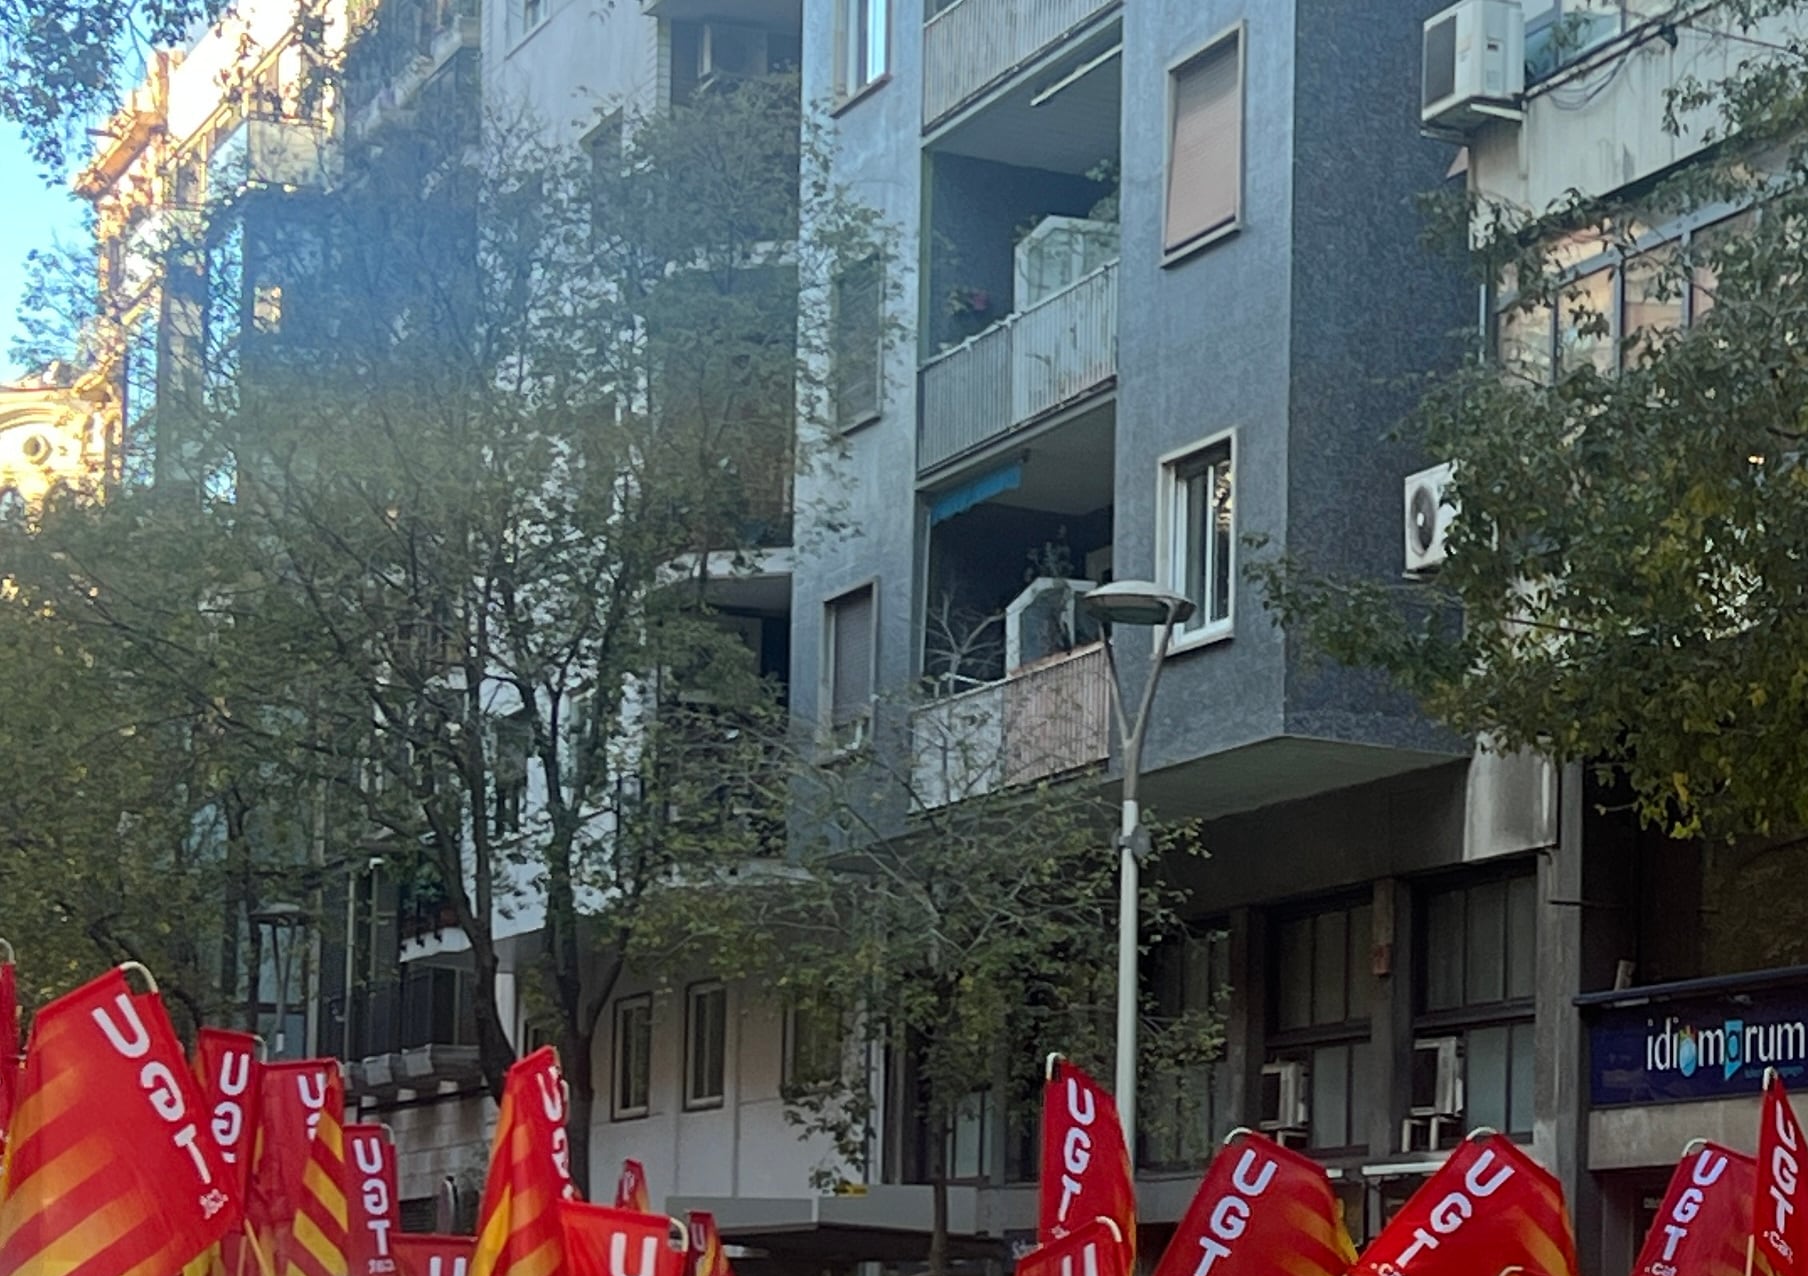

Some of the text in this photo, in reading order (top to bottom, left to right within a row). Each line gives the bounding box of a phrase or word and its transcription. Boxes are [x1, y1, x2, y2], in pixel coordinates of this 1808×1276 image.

[1059, 1077, 1096, 1223] UGT
[1395, 1149, 1516, 1269] UGT
[1661, 1150, 1728, 1261] UGT
